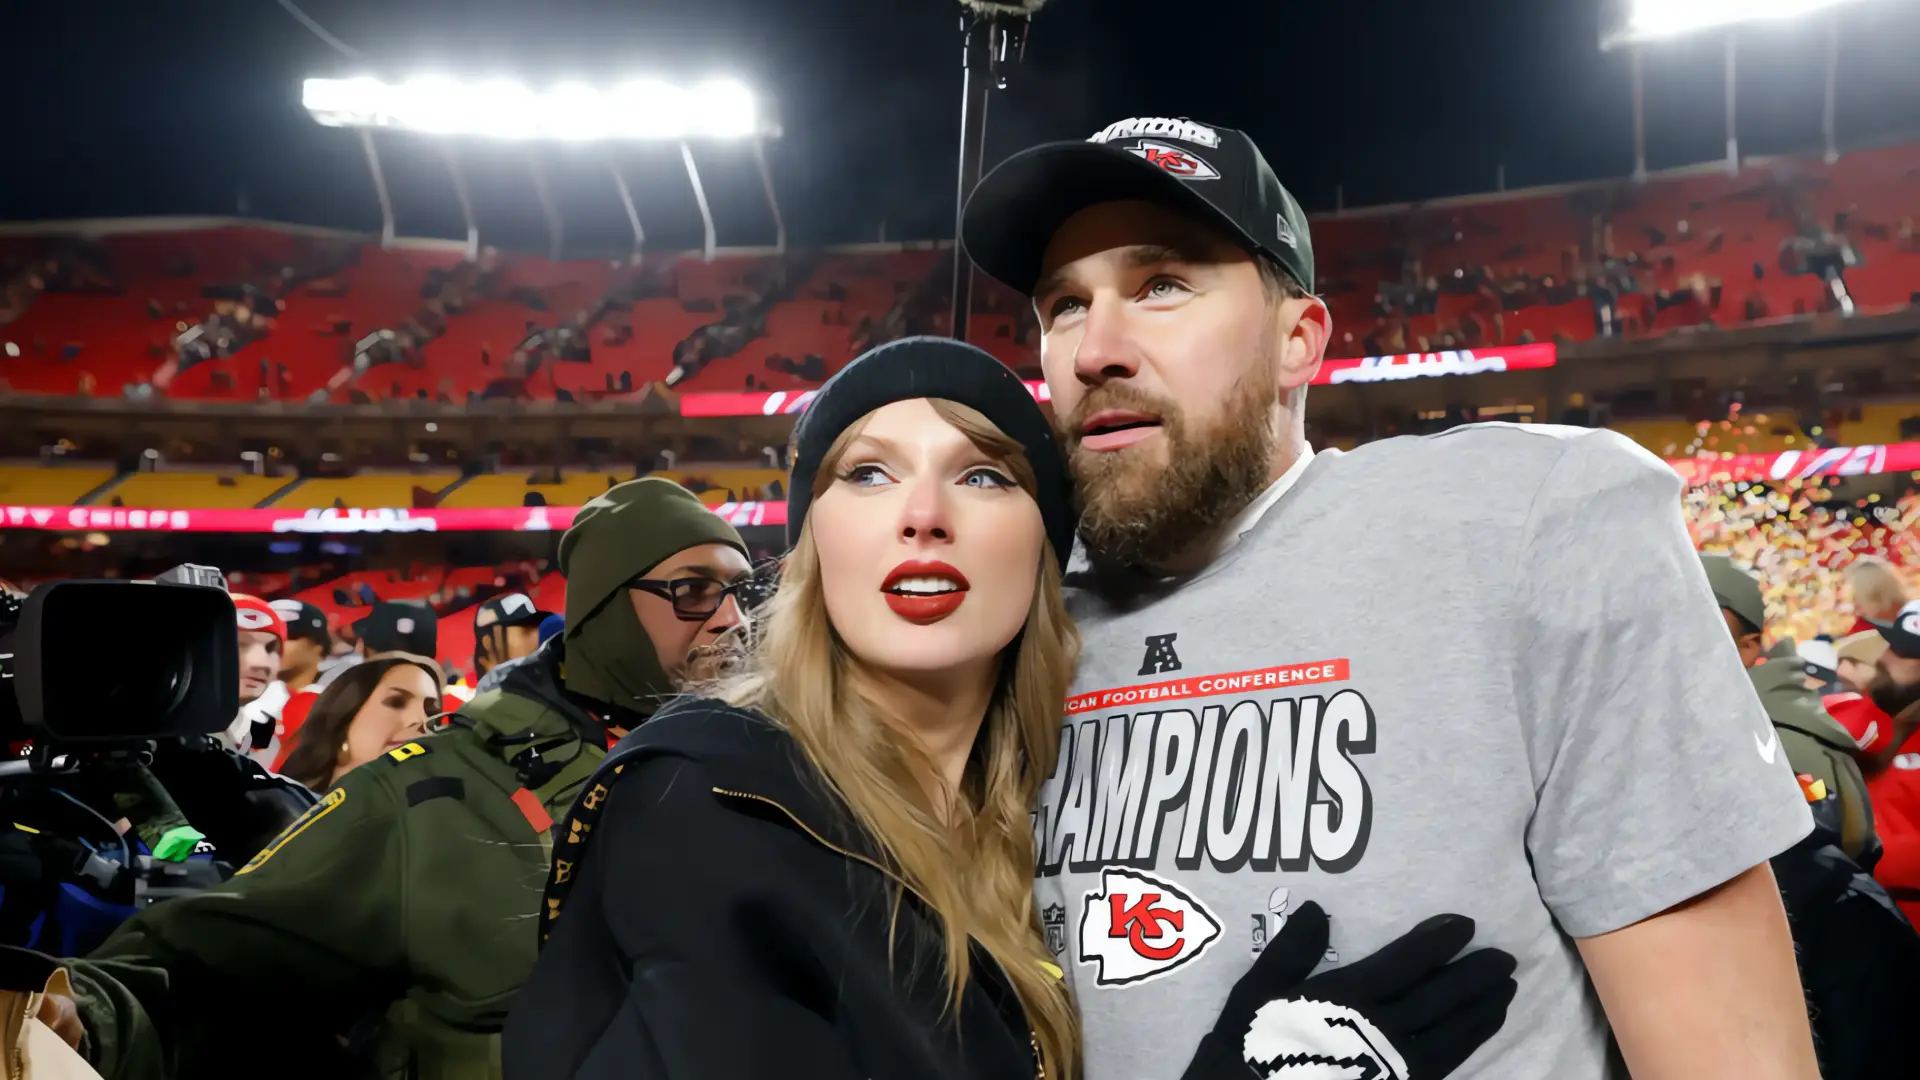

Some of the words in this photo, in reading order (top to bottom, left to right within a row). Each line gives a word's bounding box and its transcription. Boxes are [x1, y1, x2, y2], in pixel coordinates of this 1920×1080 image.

[1063, 696, 1098, 713] ICAN
[1102, 683, 1193, 705] FOOTBALL
[1198, 664, 1336, 693] CONFERENCE
[1032, 688, 1376, 877] HAMPIONS
[1108, 893, 1185, 960] KC
